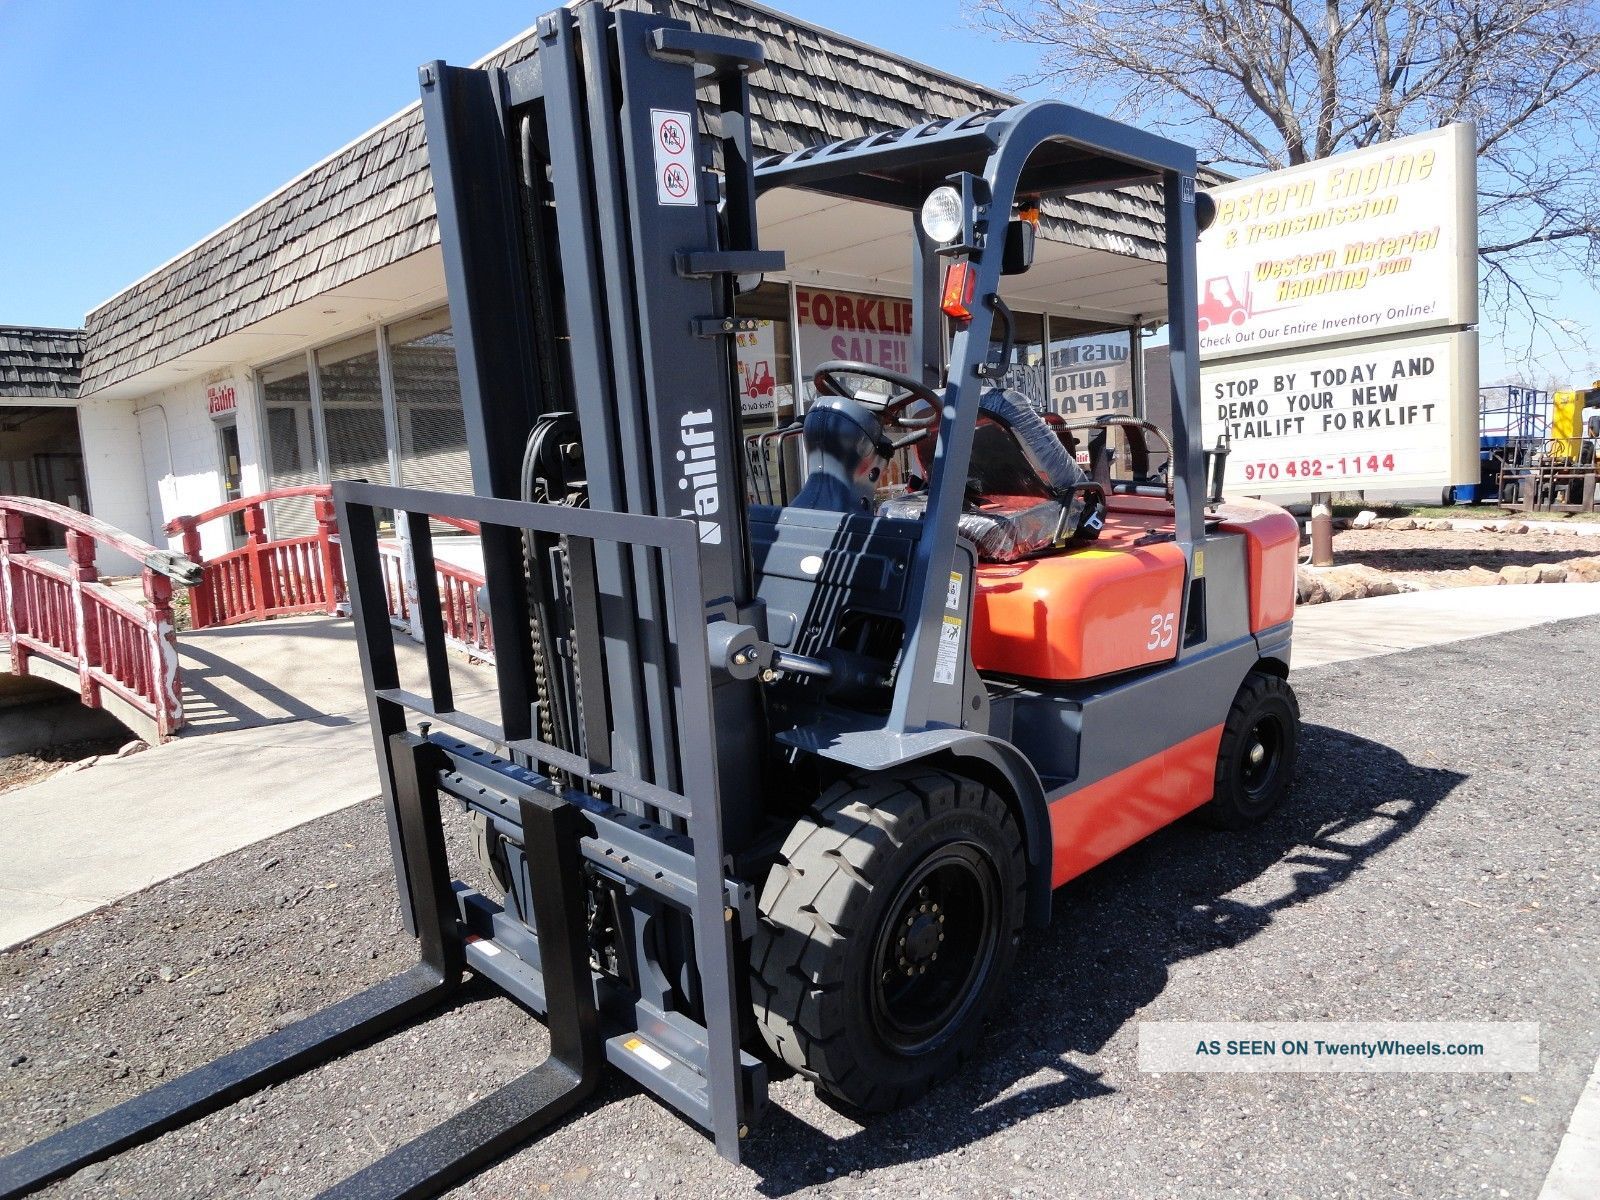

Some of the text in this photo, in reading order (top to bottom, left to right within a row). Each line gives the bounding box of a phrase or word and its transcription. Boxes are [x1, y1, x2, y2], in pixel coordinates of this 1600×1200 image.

[1214, 178, 1315, 226] estern
[1327, 148, 1436, 199] Engine
[1224, 194, 1399, 249] & Transmission
[1254, 225, 1441, 282] Western Material
[1276, 266, 1369, 302] Handling
[796, 292, 912, 336] FORKLIF
[1200, 301, 1437, 348] Check Out Our Entire Inventory Online!
[831, 335, 907, 374] SALE!!
[1214, 357, 1435, 400] STOP BY TODAY AND
[1218, 383, 1398, 421] DEMO YOUR NEW
[1231, 403, 1435, 440] TAILIFT FORKLIFT
[1245, 454, 1395, 480] 970 482-1144
[1147, 613, 1174, 650] 35
